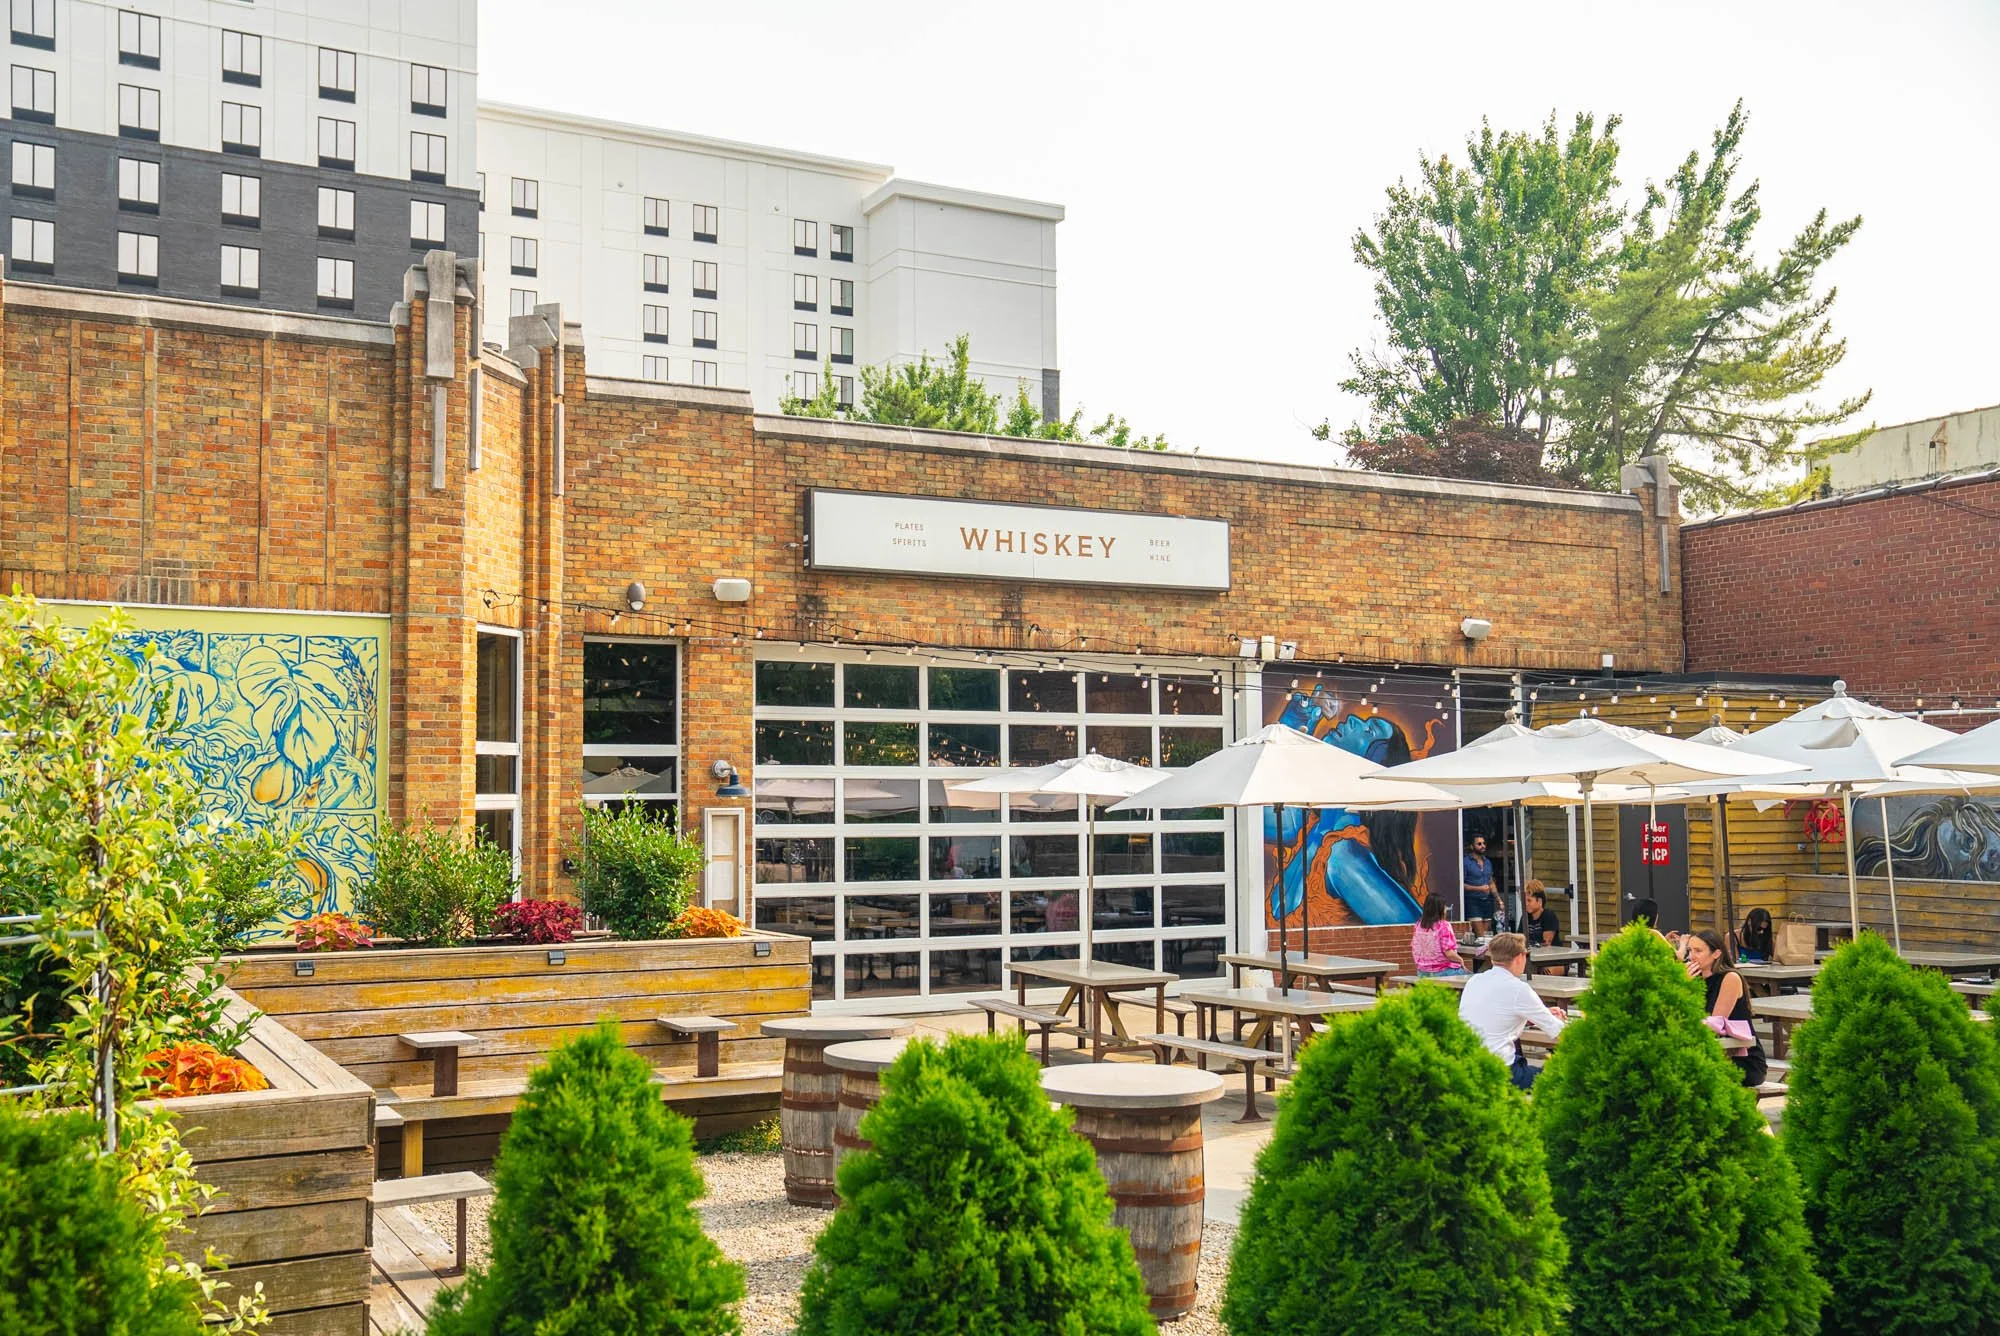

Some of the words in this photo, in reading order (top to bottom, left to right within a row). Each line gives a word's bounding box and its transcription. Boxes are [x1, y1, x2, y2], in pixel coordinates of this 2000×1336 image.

[895, 522, 924, 531] PLATES
[892, 537, 927, 546] SPIRITS
[960, 527, 1116, 559] WHISKEY
[1149, 538, 1170, 546] BEER
